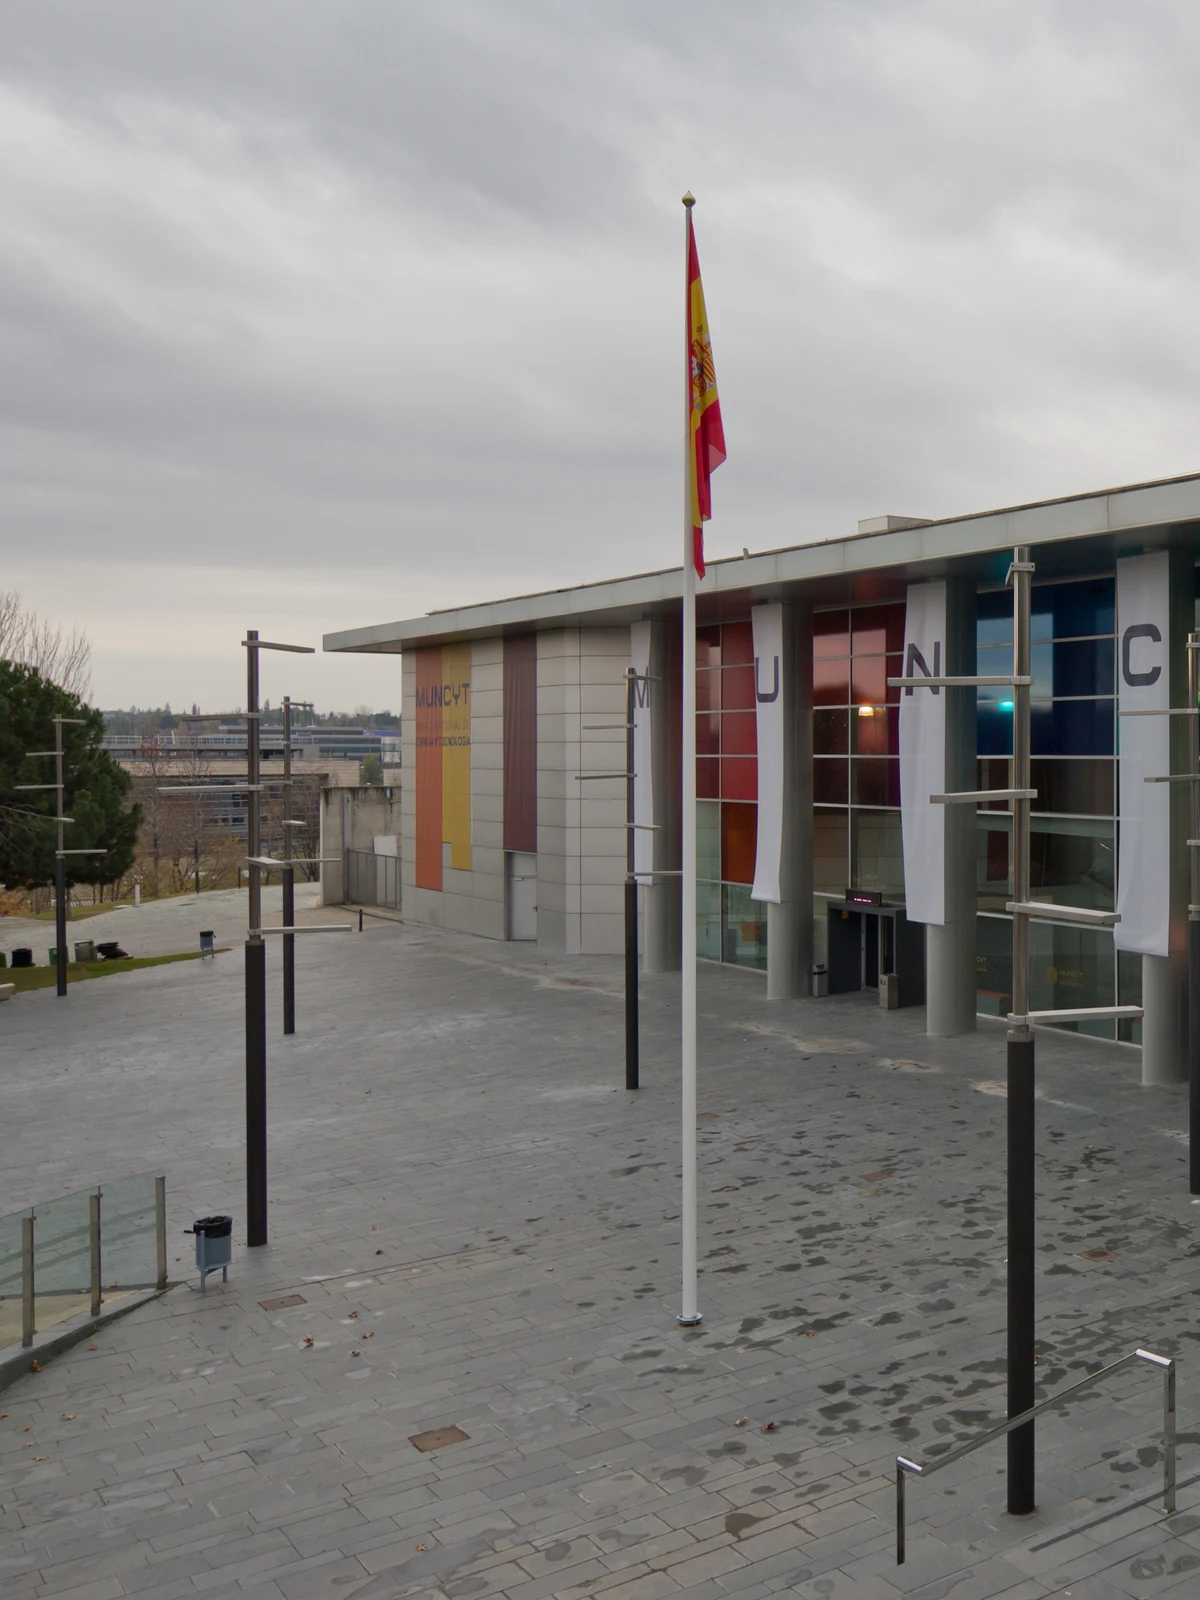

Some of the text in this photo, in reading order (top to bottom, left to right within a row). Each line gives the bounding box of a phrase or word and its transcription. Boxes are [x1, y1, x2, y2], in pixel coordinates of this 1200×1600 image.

[755, 655, 779, 703] U
[905, 641, 940, 696] N
[1122, 623, 1161, 687] C
[416, 683, 470, 708] MUNCYT
[632, 666, 650, 709] M
